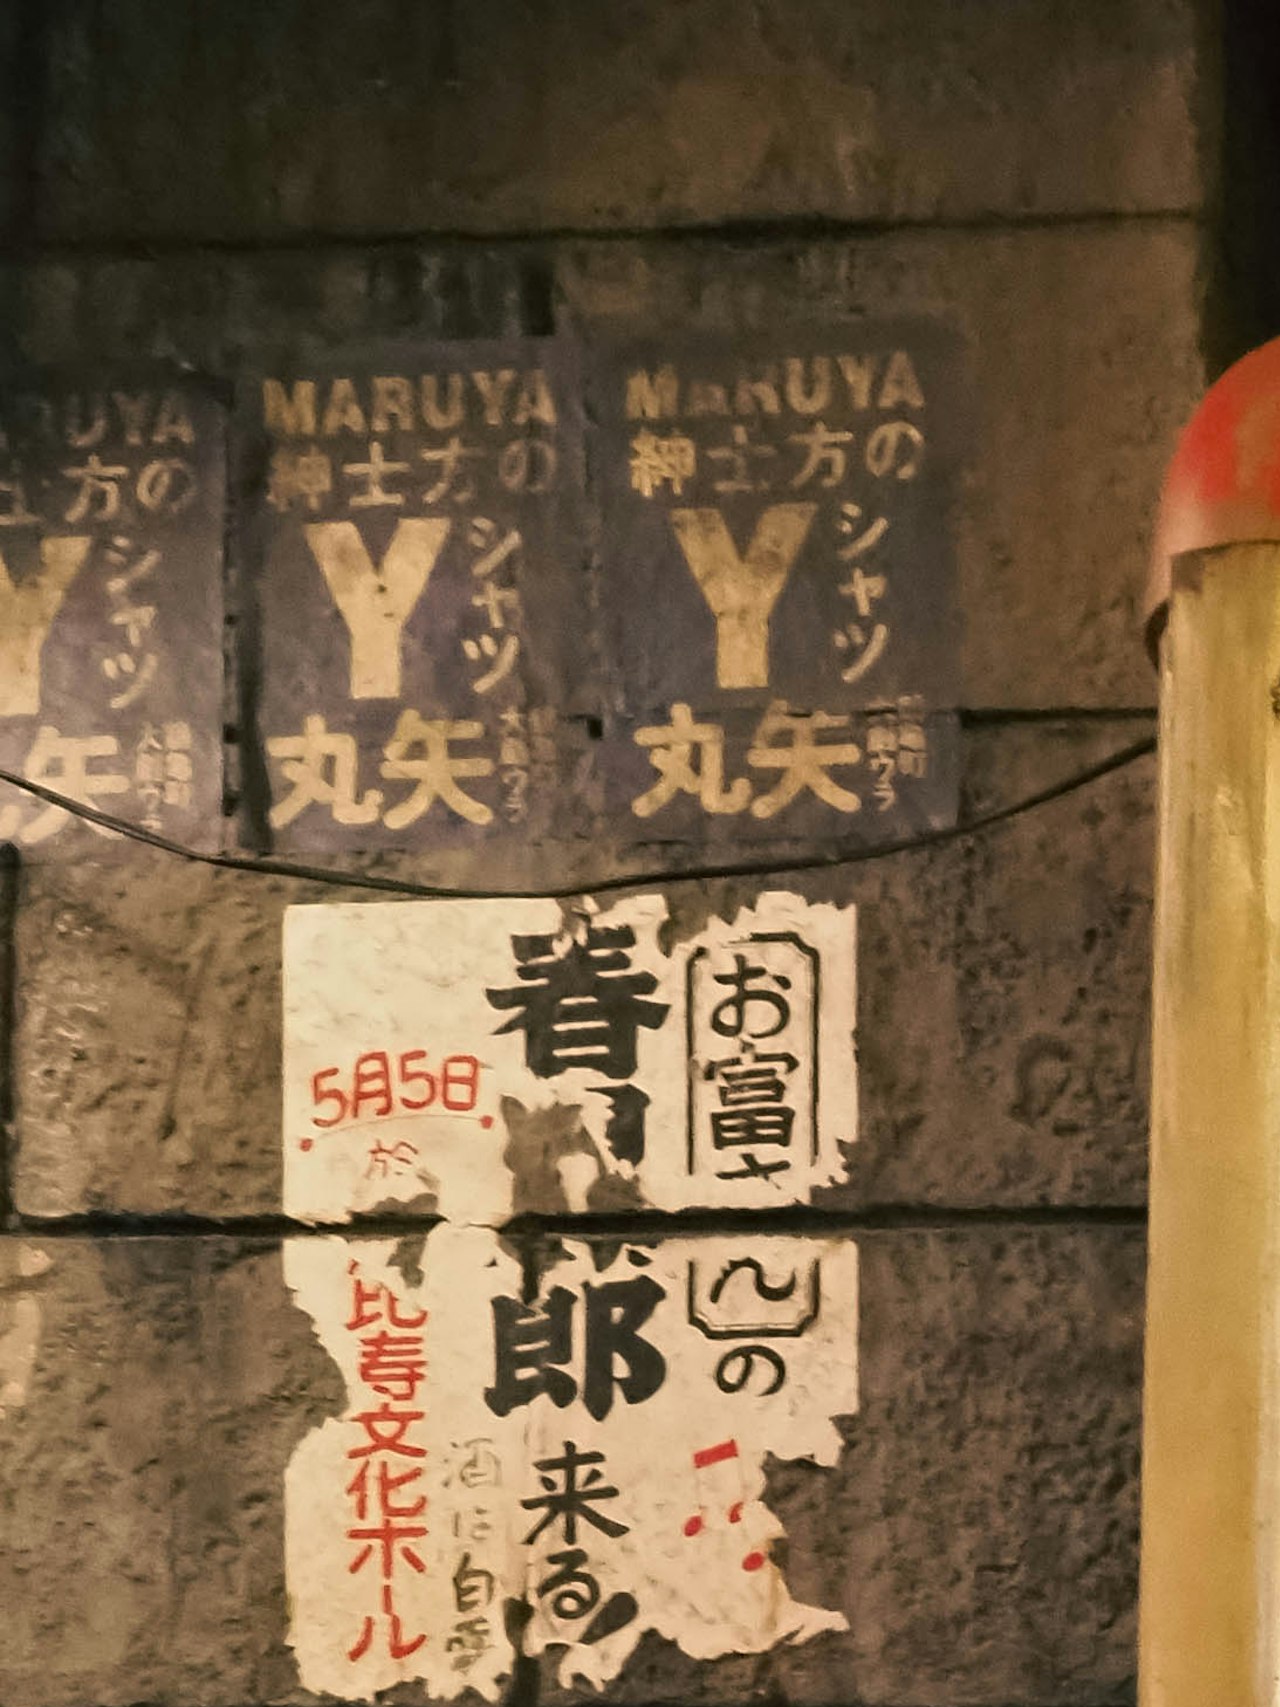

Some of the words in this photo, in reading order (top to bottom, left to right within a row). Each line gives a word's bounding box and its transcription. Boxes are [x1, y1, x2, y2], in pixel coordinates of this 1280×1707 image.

[264, 369, 557, 437] MARUYA
[626, 350, 926, 419] MARUYA
[267, 439, 557, 513] 紳士方の
[629, 420, 926, 498] 紳士方の
[303, 517, 452, 699] Y
[462, 515, 523, 693] シャツ
[673, 502, 817, 689] Y
[834, 501, 892, 683] シャツ
[0, 726, 130, 845] 矢
[268, 708, 495, 831] 丸矢
[633, 700, 863, 819] 丸矢
[312, 1050, 481, 1129] 5月5日
[347, 1264, 427, 1662] 比寿文化ホール
